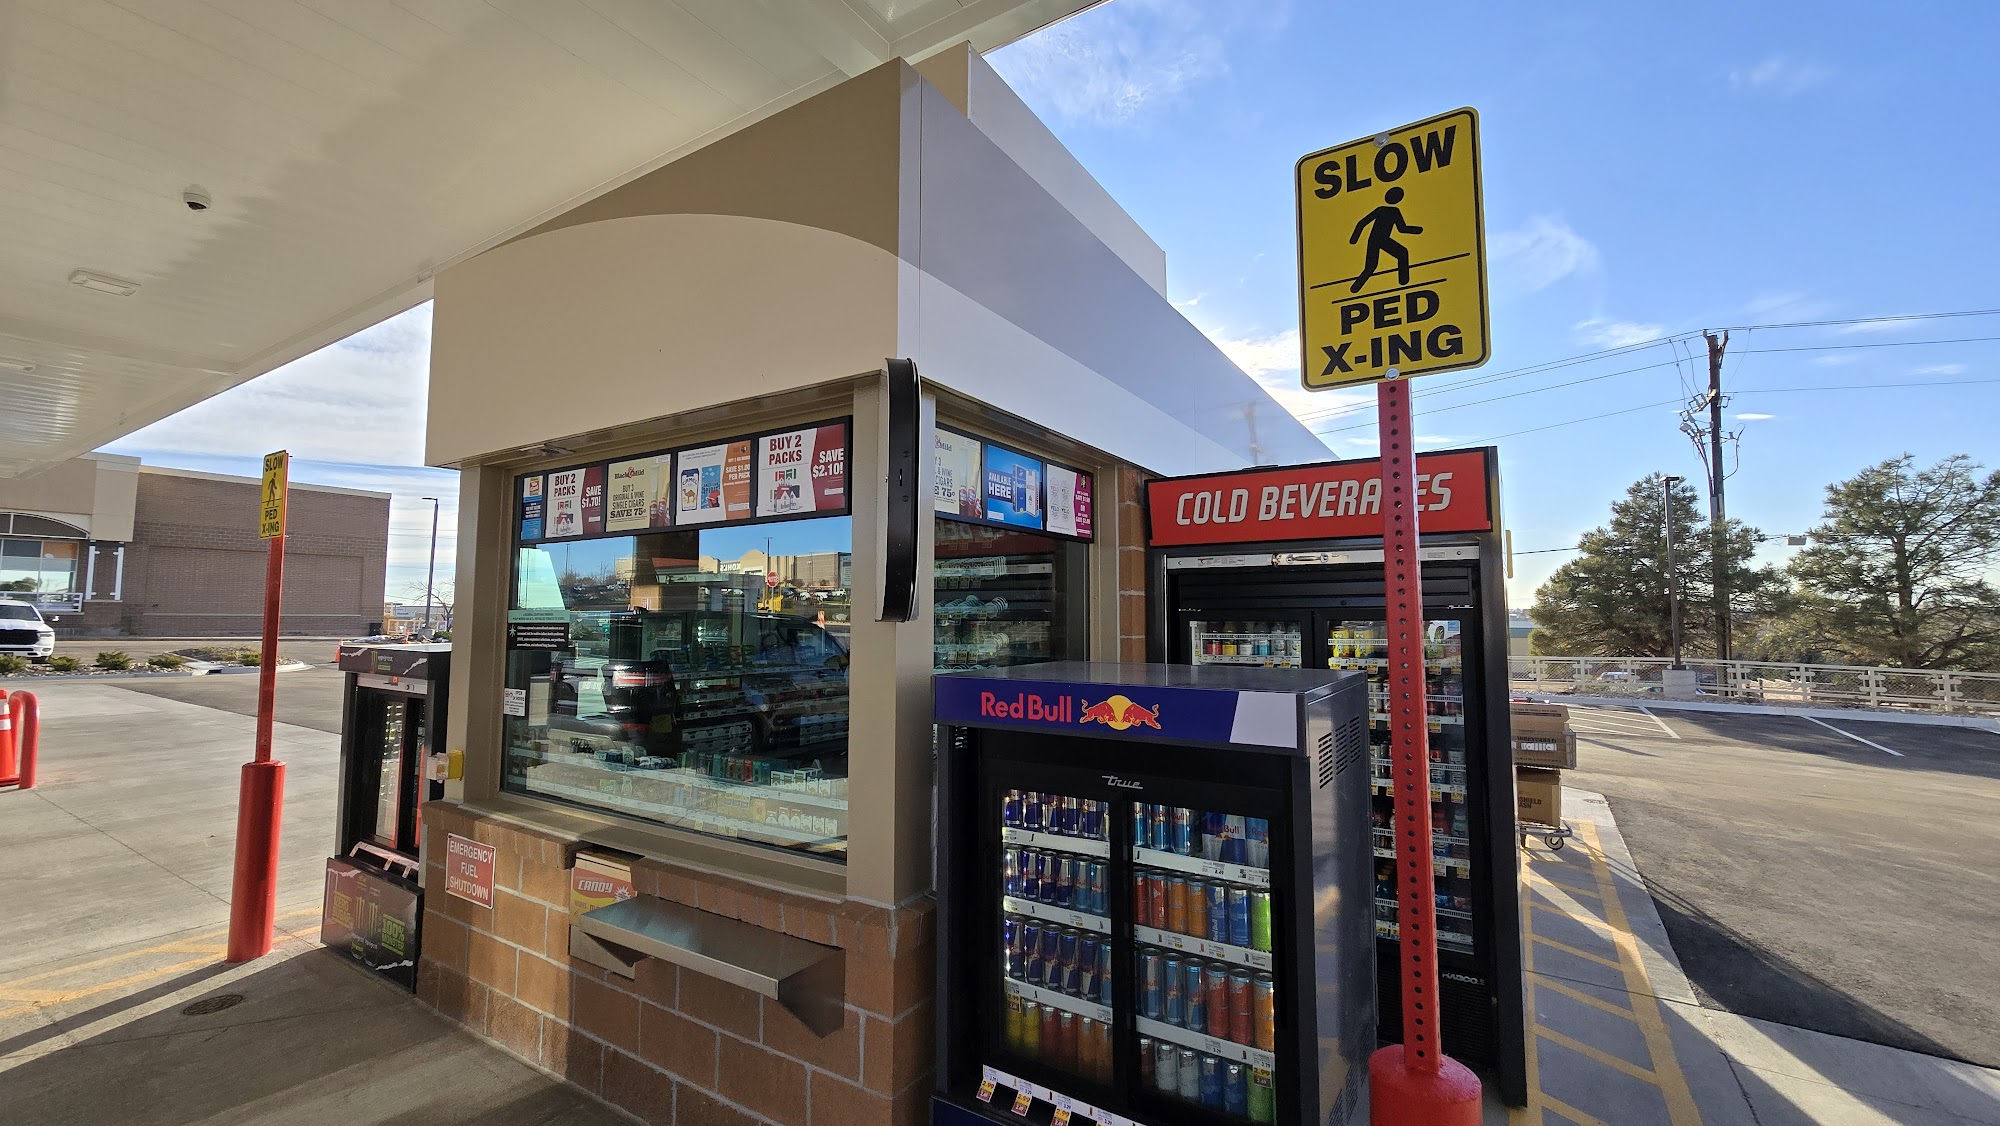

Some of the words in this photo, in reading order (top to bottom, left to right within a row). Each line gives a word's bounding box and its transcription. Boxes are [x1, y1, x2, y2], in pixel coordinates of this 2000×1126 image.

[1314, 125, 1457, 199] SLOW
[1340, 290, 1440, 335] PED
[1321, 325, 1464, 376] X-ING
[770, 436, 792, 451] BUY
[795, 435, 802, 447] 2
[769, 450, 802, 465] PACKS
[819, 448, 844, 463] SAVE
[265, 455, 284, 472] SLOW
[813, 462, 843, 479] $2.10!
[555, 475, 570, 486] BUY
[571, 473, 576, 484] 2
[936, 475, 953, 488] CIGARS
[989, 472, 1011, 485] AVAILABLE
[554, 486, 576, 497] PACKS
[586, 485, 602, 497] SAVE
[988, 482, 1011, 499] HERE
[582, 496, 601, 508] $1.70!
[613, 500, 628, 510] SINGLE
[629, 499, 645, 508] CIGARS
[1176, 488, 1249, 525] COLD
[1258, 472, 1453, 521] BEVERAES
[265, 509, 277, 521] PED
[610, 509, 632, 518] SAVE
[262, 521, 279, 534] X-ING
[981, 691, 1024, 719] Red
[1028, 695, 1072, 723] Bull
[1518, 797, 1541, 805] SHIELD
[1224, 825, 1240, 834] Bull
[1252, 827, 1268, 837] Red
[450, 840, 493, 865] EMERGENCY
[460, 862, 479, 879] FUEL
[449, 877, 489, 901] SHUTDOWN
[578, 880, 613, 893] CANDY
[383, 920, 404, 944] 100%
[1254, 1068, 1270, 1076] 2.99
[982, 1081, 994, 1089] 2.99
[1017, 1094, 1031, 1102] 2.99
[1057, 1108, 1069, 1117] 2.99
